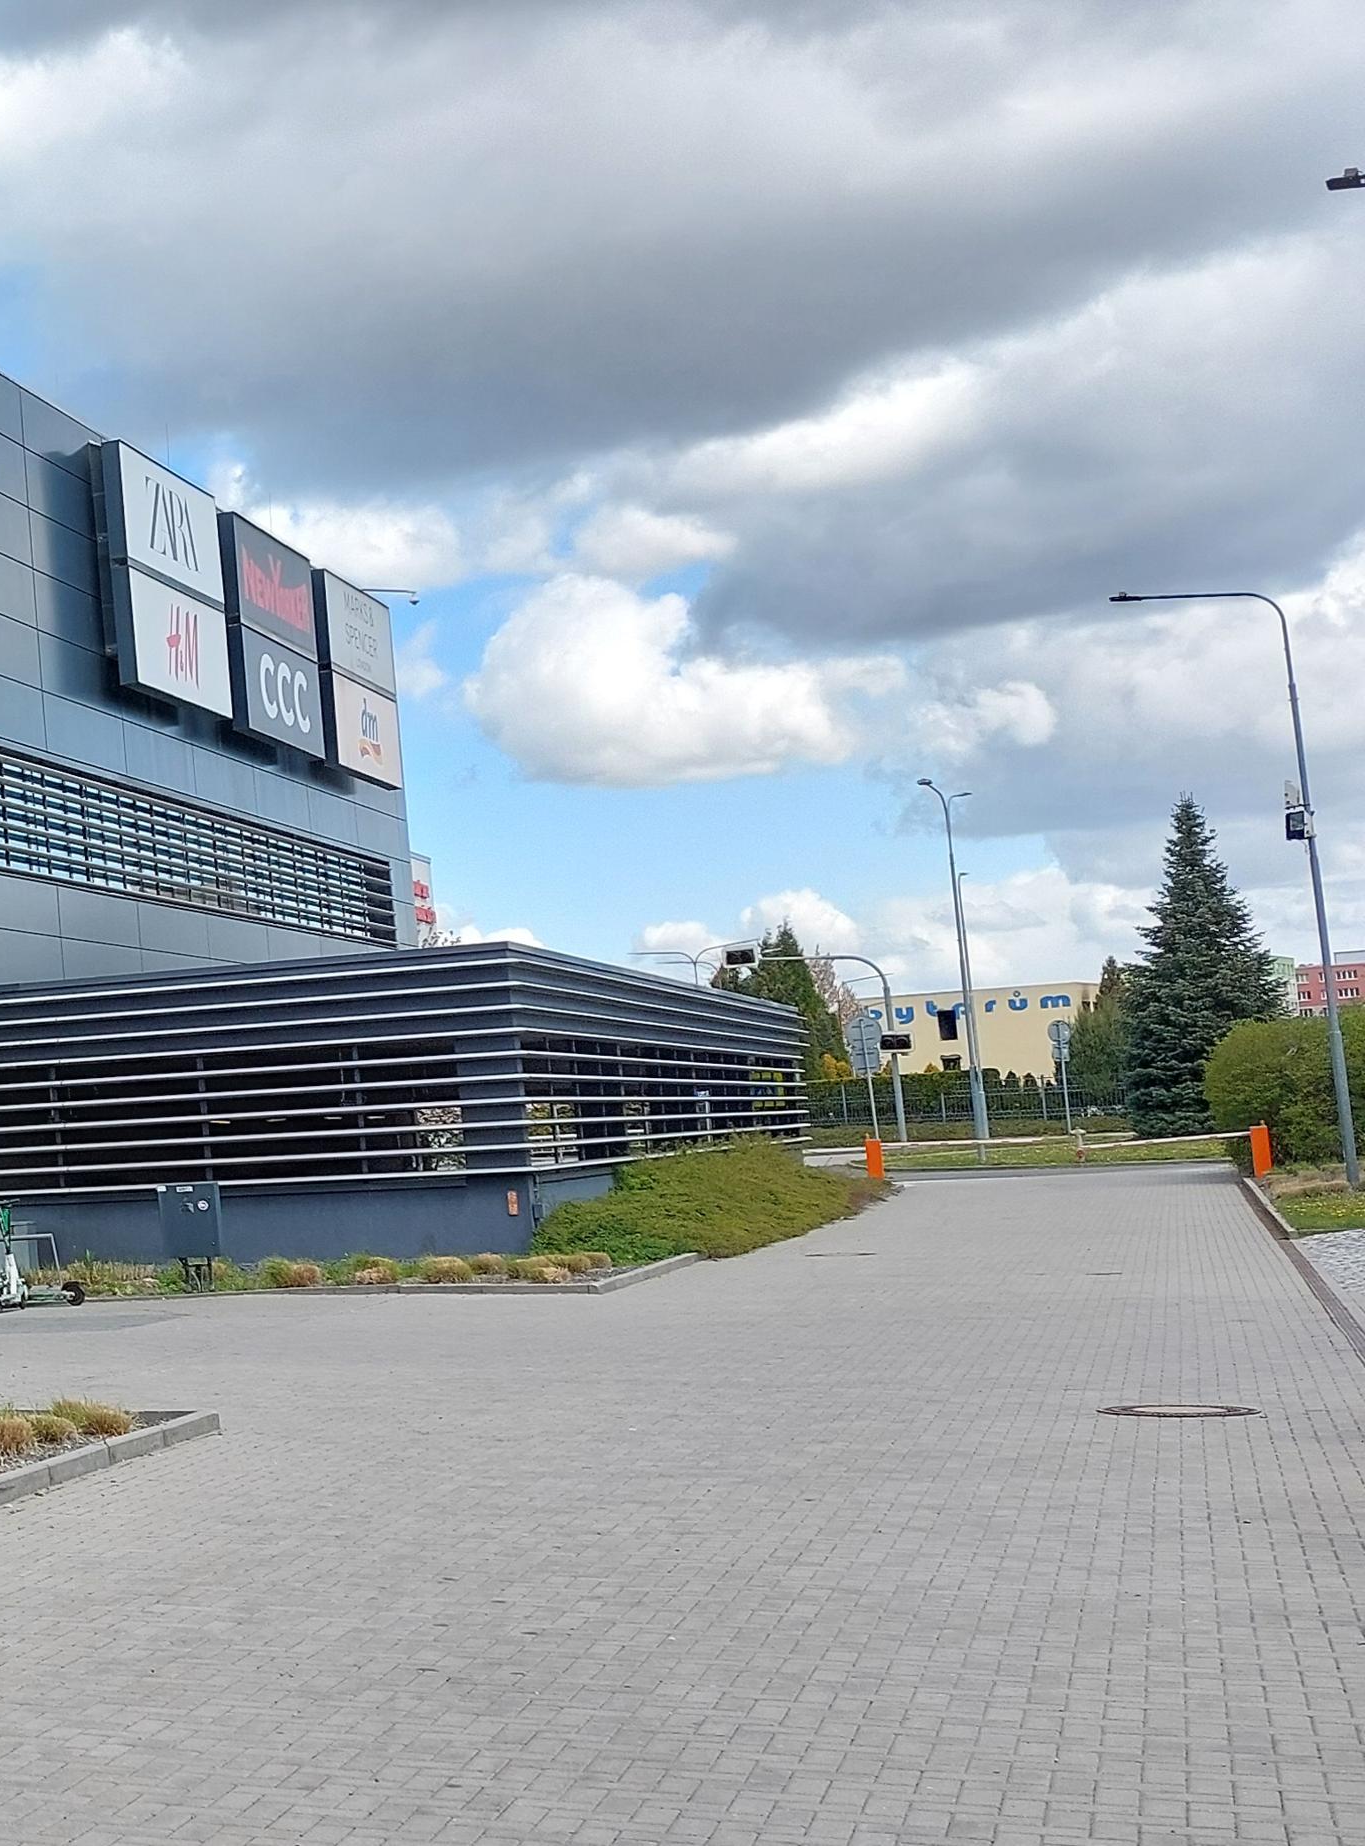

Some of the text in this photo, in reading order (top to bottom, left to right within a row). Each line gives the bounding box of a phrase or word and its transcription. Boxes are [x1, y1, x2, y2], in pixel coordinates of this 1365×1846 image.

[145, 476, 199, 571] ZARA
[166, 604, 200, 689] H&M
[260, 653, 311, 733] CCC
[361, 698, 379, 742] dm
